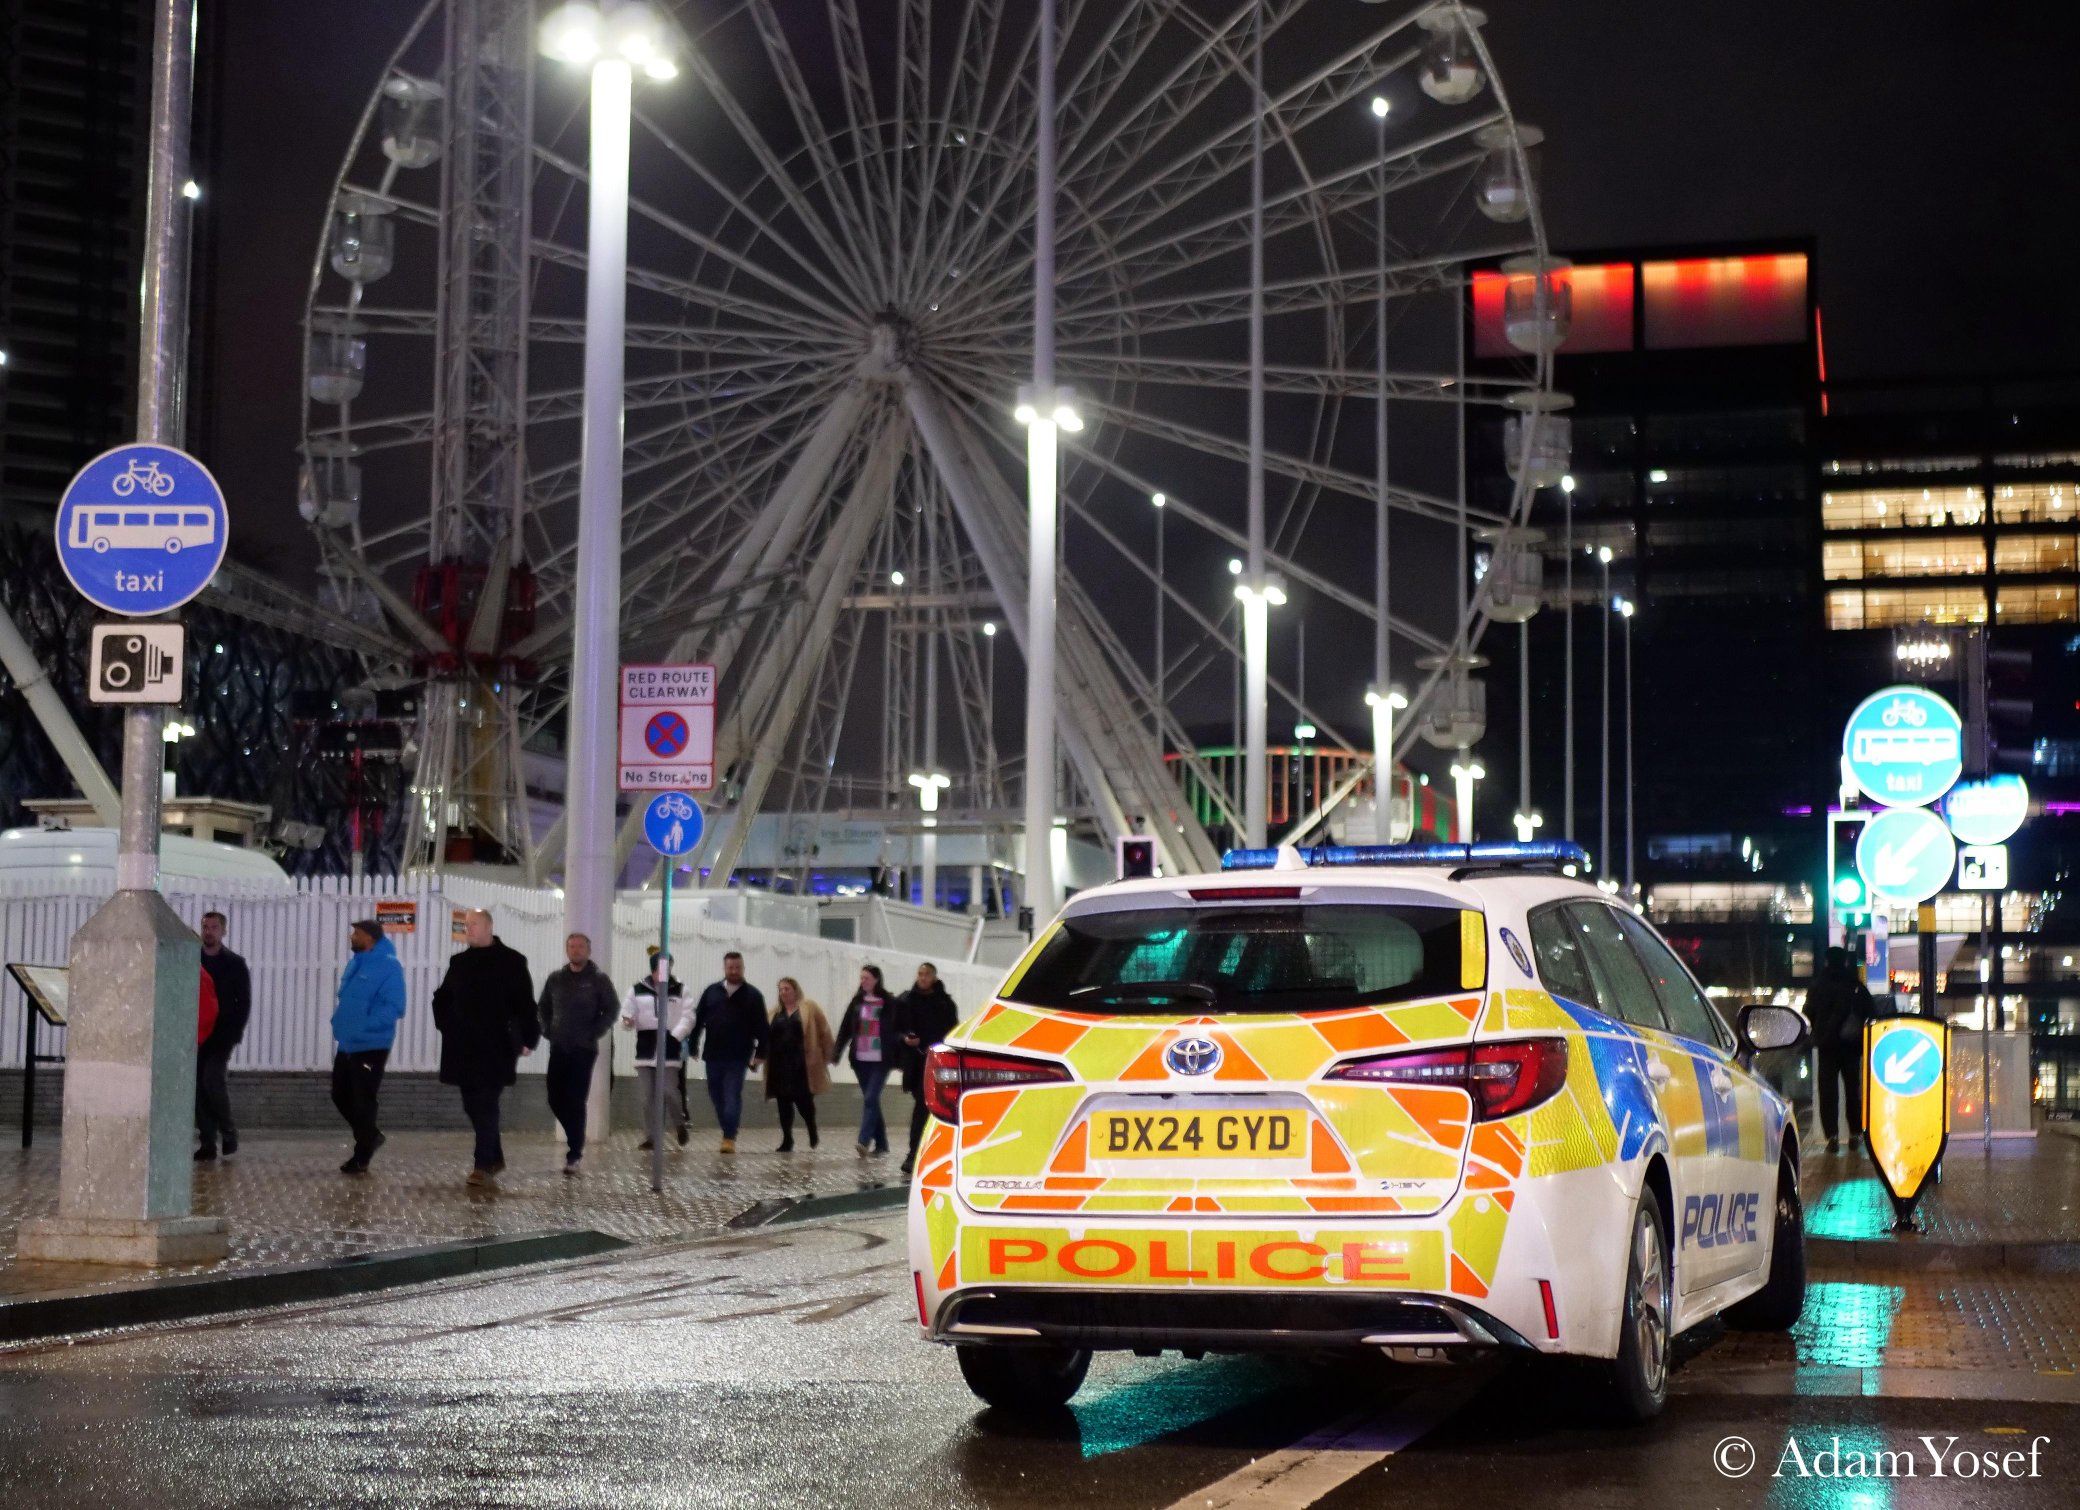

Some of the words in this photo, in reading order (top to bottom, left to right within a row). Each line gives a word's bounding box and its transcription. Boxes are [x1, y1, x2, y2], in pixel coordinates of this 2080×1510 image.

[115, 570, 164, 592] taxi
[628, 672, 657, 684] RED
[662, 671, 710, 683] ROUTE
[629, 686, 708, 698] CLEARWAY
[625, 771, 643, 783] No
[1886, 772, 1923, 792] taxi
[1108, 1116, 1204, 1152] BX24
[1217, 1115, 1291, 1151] GYD
[975, 1180, 1043, 1190] COROLLA
[1681, 1192, 1759, 1251] POLICE
[988, 1238, 1411, 1281] POLICE
